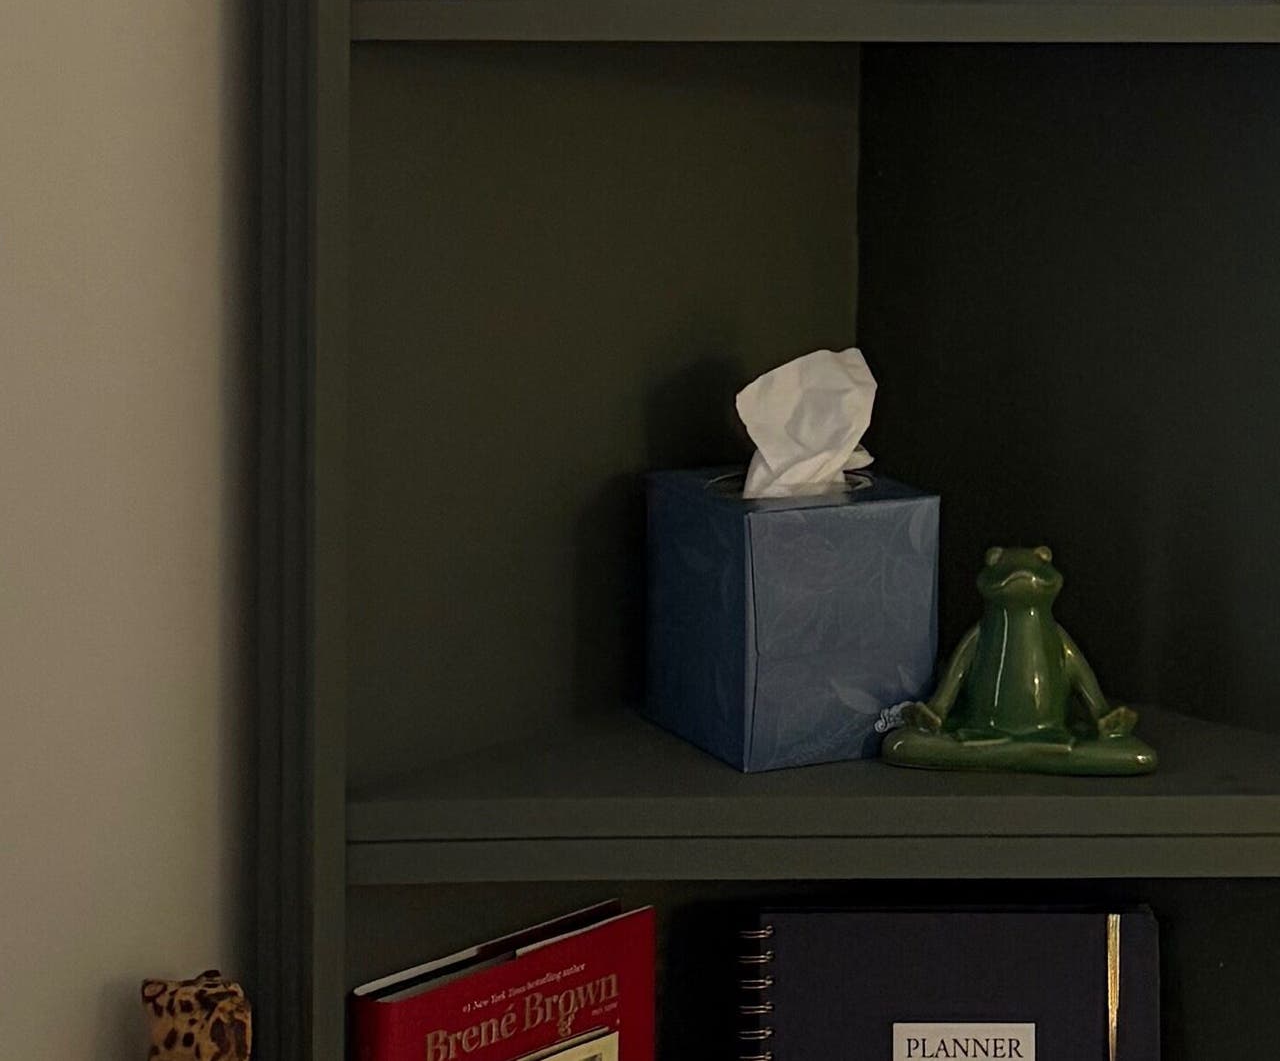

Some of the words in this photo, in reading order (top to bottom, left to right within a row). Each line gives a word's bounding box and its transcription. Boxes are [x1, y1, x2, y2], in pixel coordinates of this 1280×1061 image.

[473, 1000, 489, 1011] New
[490, 990, 507, 1005] York
[508, 985, 527, 998] Times
[527, 972, 562, 992] bestselling
[563, 963, 587, 979] author
[426, 1003, 519, 1061] Brené
[523, 974, 620, 1032] Brown
[905, 1037, 1024, 1059] PLANNER
